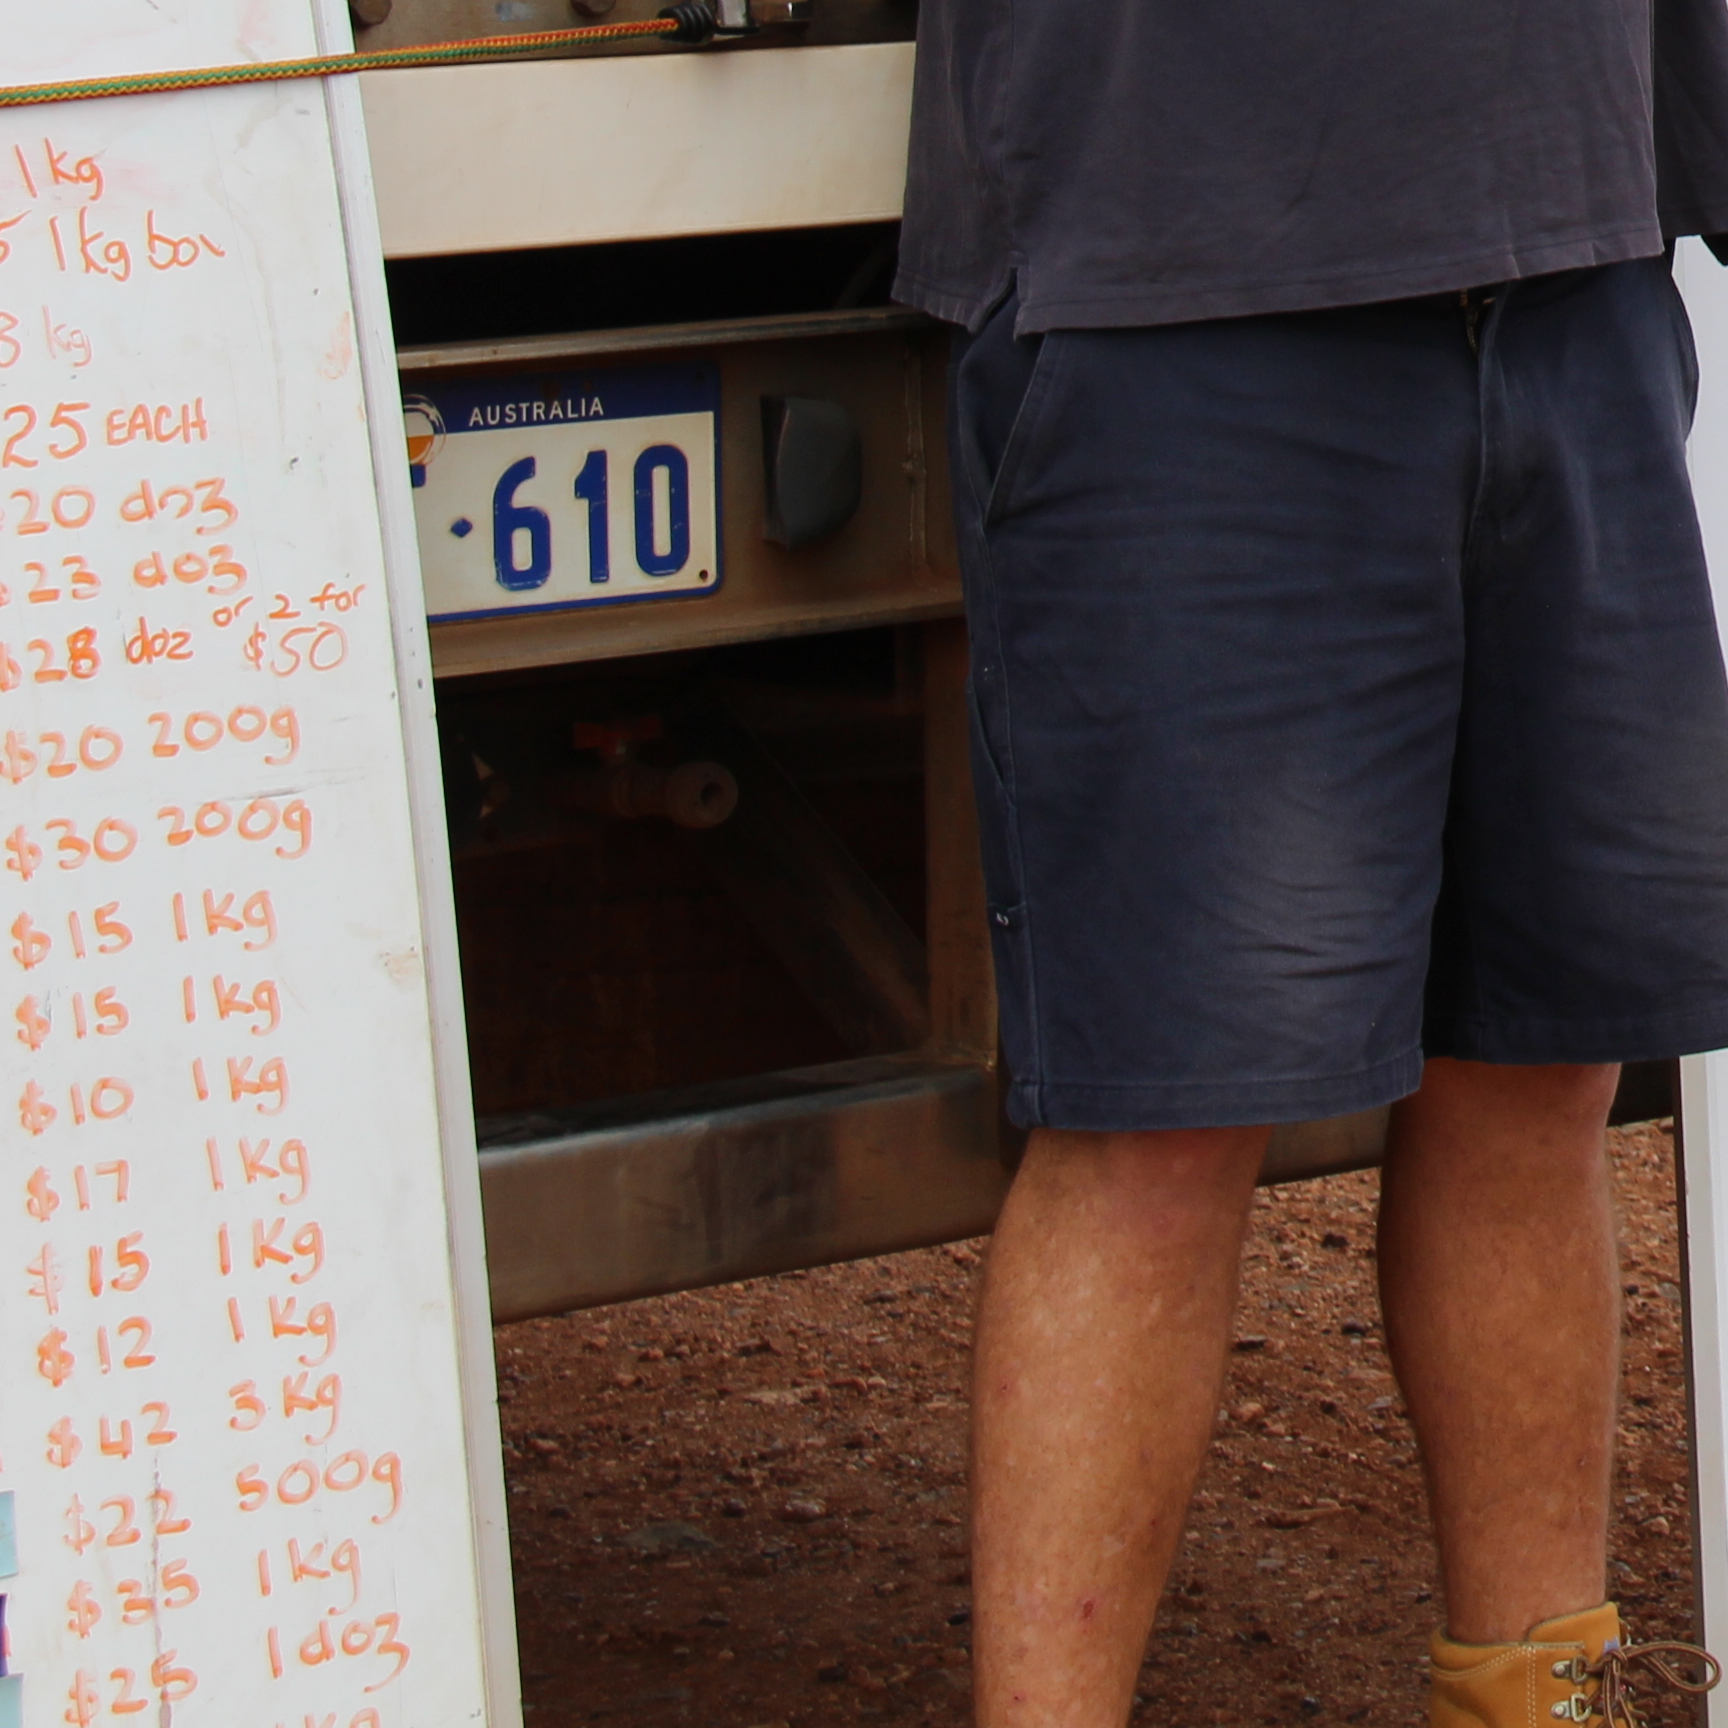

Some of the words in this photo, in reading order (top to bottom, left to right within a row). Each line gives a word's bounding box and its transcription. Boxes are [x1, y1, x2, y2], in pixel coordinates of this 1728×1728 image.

[103, 397, 209, 447] EACH
[468, 396, 606, 428] AUSTRALIA
[492, 443, 691, 592] 610
[145, 705, 301, 766] 200g
[155, 796, 313, 860] 200g
